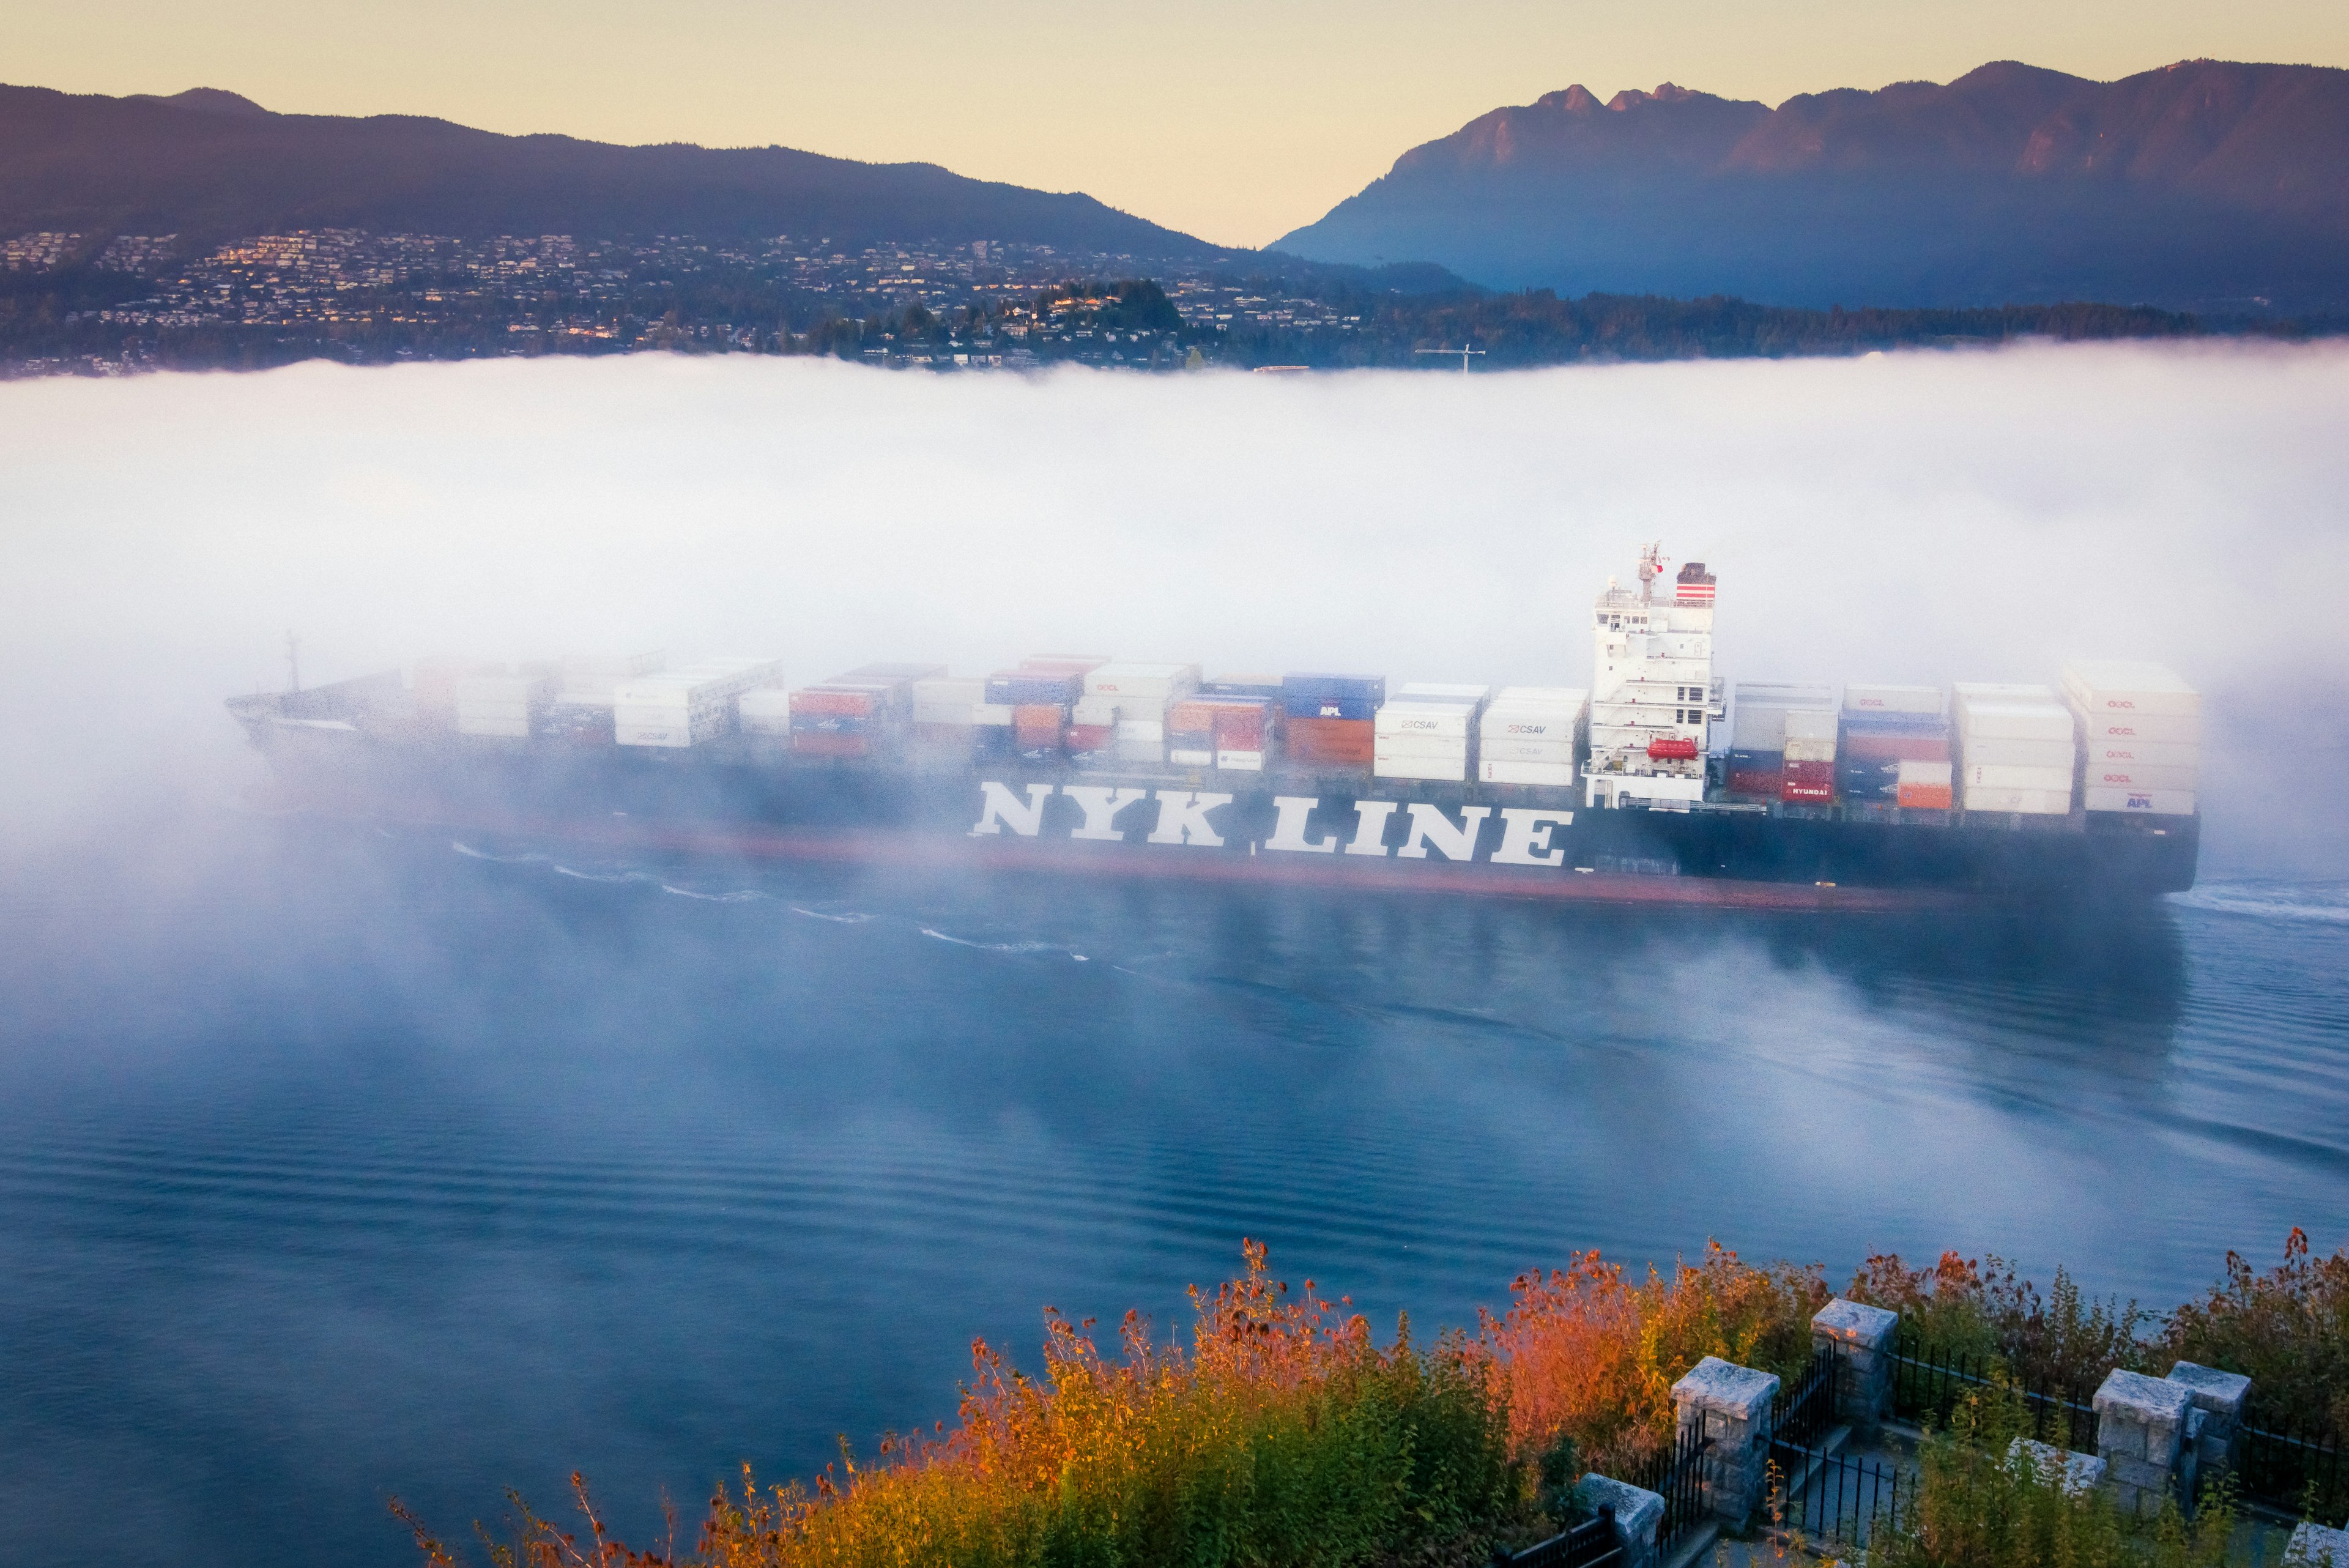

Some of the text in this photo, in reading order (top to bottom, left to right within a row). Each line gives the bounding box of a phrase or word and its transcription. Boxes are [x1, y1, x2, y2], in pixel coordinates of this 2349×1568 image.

[1320, 707, 1341, 716] APL
[1413, 721, 1438, 729] CSAV
[1520, 726, 1546, 734] CSAV
[2108, 727, 2136, 735] OOCL
[2106, 750, 2134, 759] OOCL
[2104, 774, 2132, 782] OOCL
[2126, 798, 2152, 808] APL
[973, 781, 1574, 866] NYK LINE
